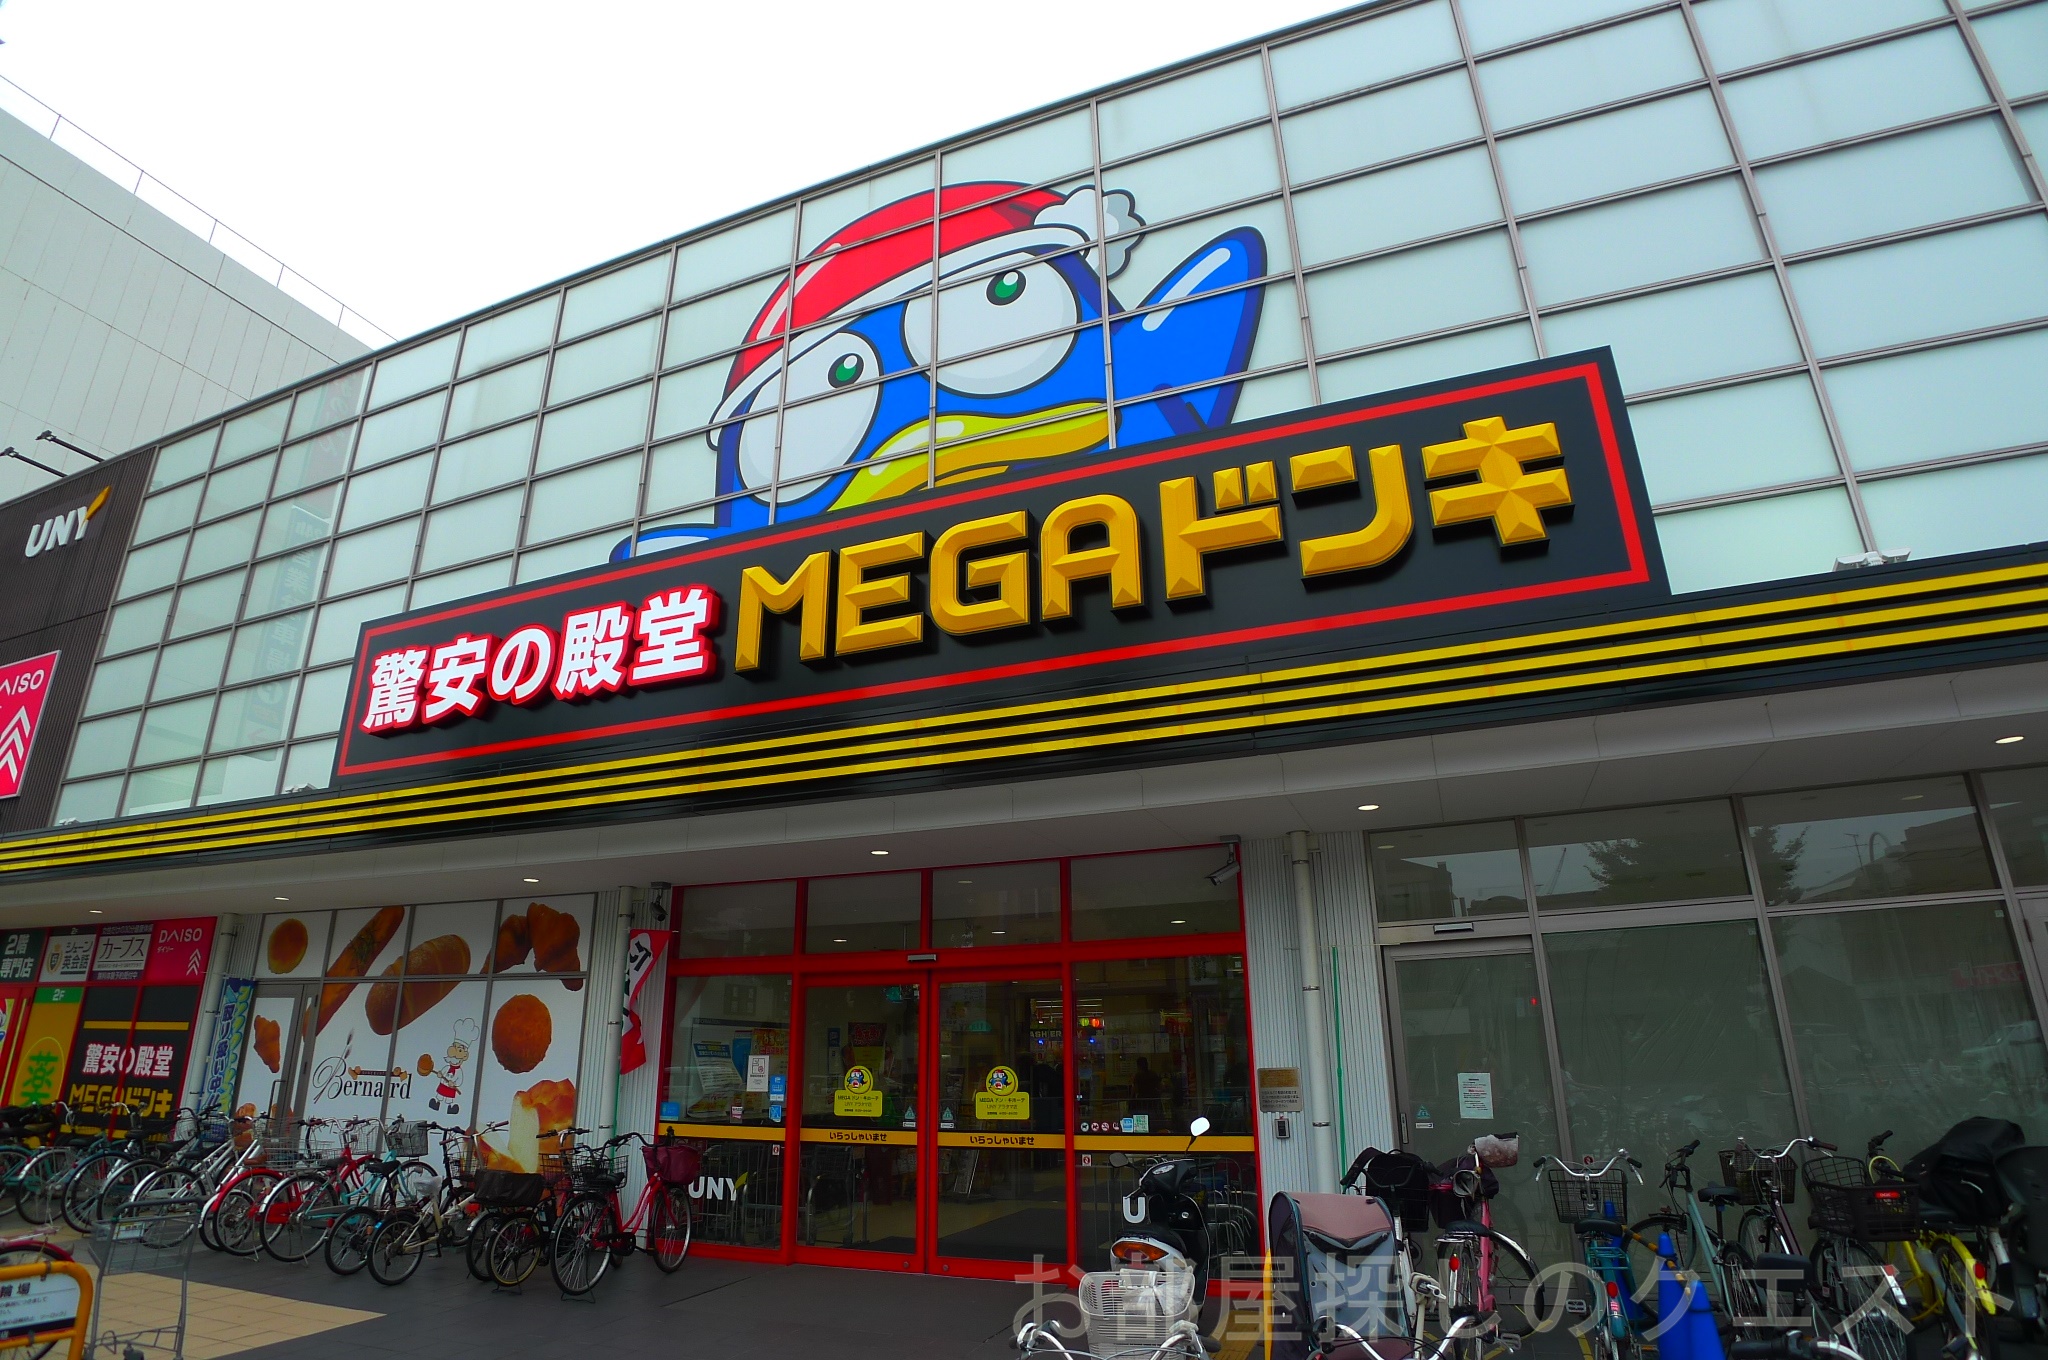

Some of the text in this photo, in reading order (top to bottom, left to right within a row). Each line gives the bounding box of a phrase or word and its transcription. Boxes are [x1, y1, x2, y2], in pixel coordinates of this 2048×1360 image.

[25, 490, 107, 558] UNY
[734, 415, 1574, 672] MEGAドンキ
[361, 585, 714, 731] 驚安の殿堂
[4, 933, 30, 955] 2階
[158, 928, 202, 943] DAISO
[65, 940, 93, 954] シェーン
[99, 937, 145, 960] カーブス
[0, 957, 34, 978] 専門店
[61, 954, 90, 969] 英会話
[52, 988, 66, 1001] 2F
[82, 1043, 174, 1077] 驚安の殿堂
[312, 1055, 412, 1104] Bernard
[829, 1131, 887, 1142] いらっしゃいませ
[970, 1134, 1035, 1146] いらっしゃいませ
[688, 1172, 746, 1201] UNY
